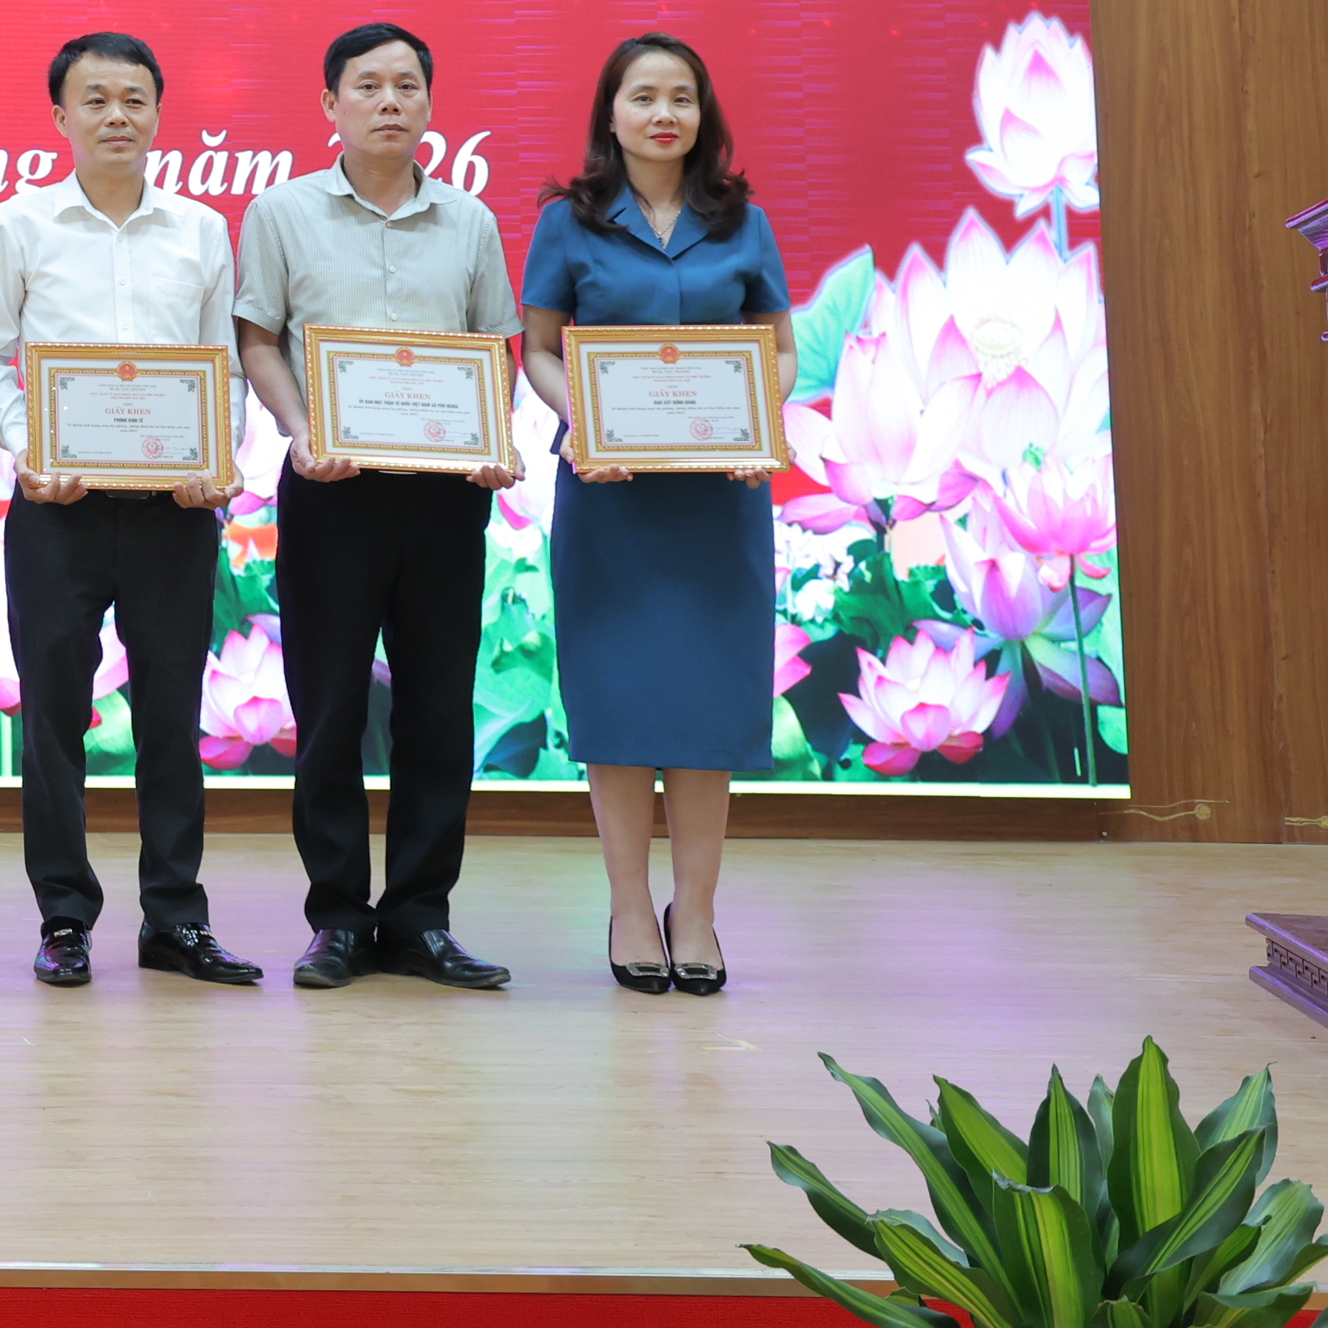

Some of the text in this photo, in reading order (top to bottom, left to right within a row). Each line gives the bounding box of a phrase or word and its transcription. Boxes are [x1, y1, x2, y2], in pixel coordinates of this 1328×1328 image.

[143, 129, 294, 196] năm
[384, 390, 406, 398] GIẤY
[648, 388, 670, 397] GIẤY
[105, 406, 125, 415] GIẤY
